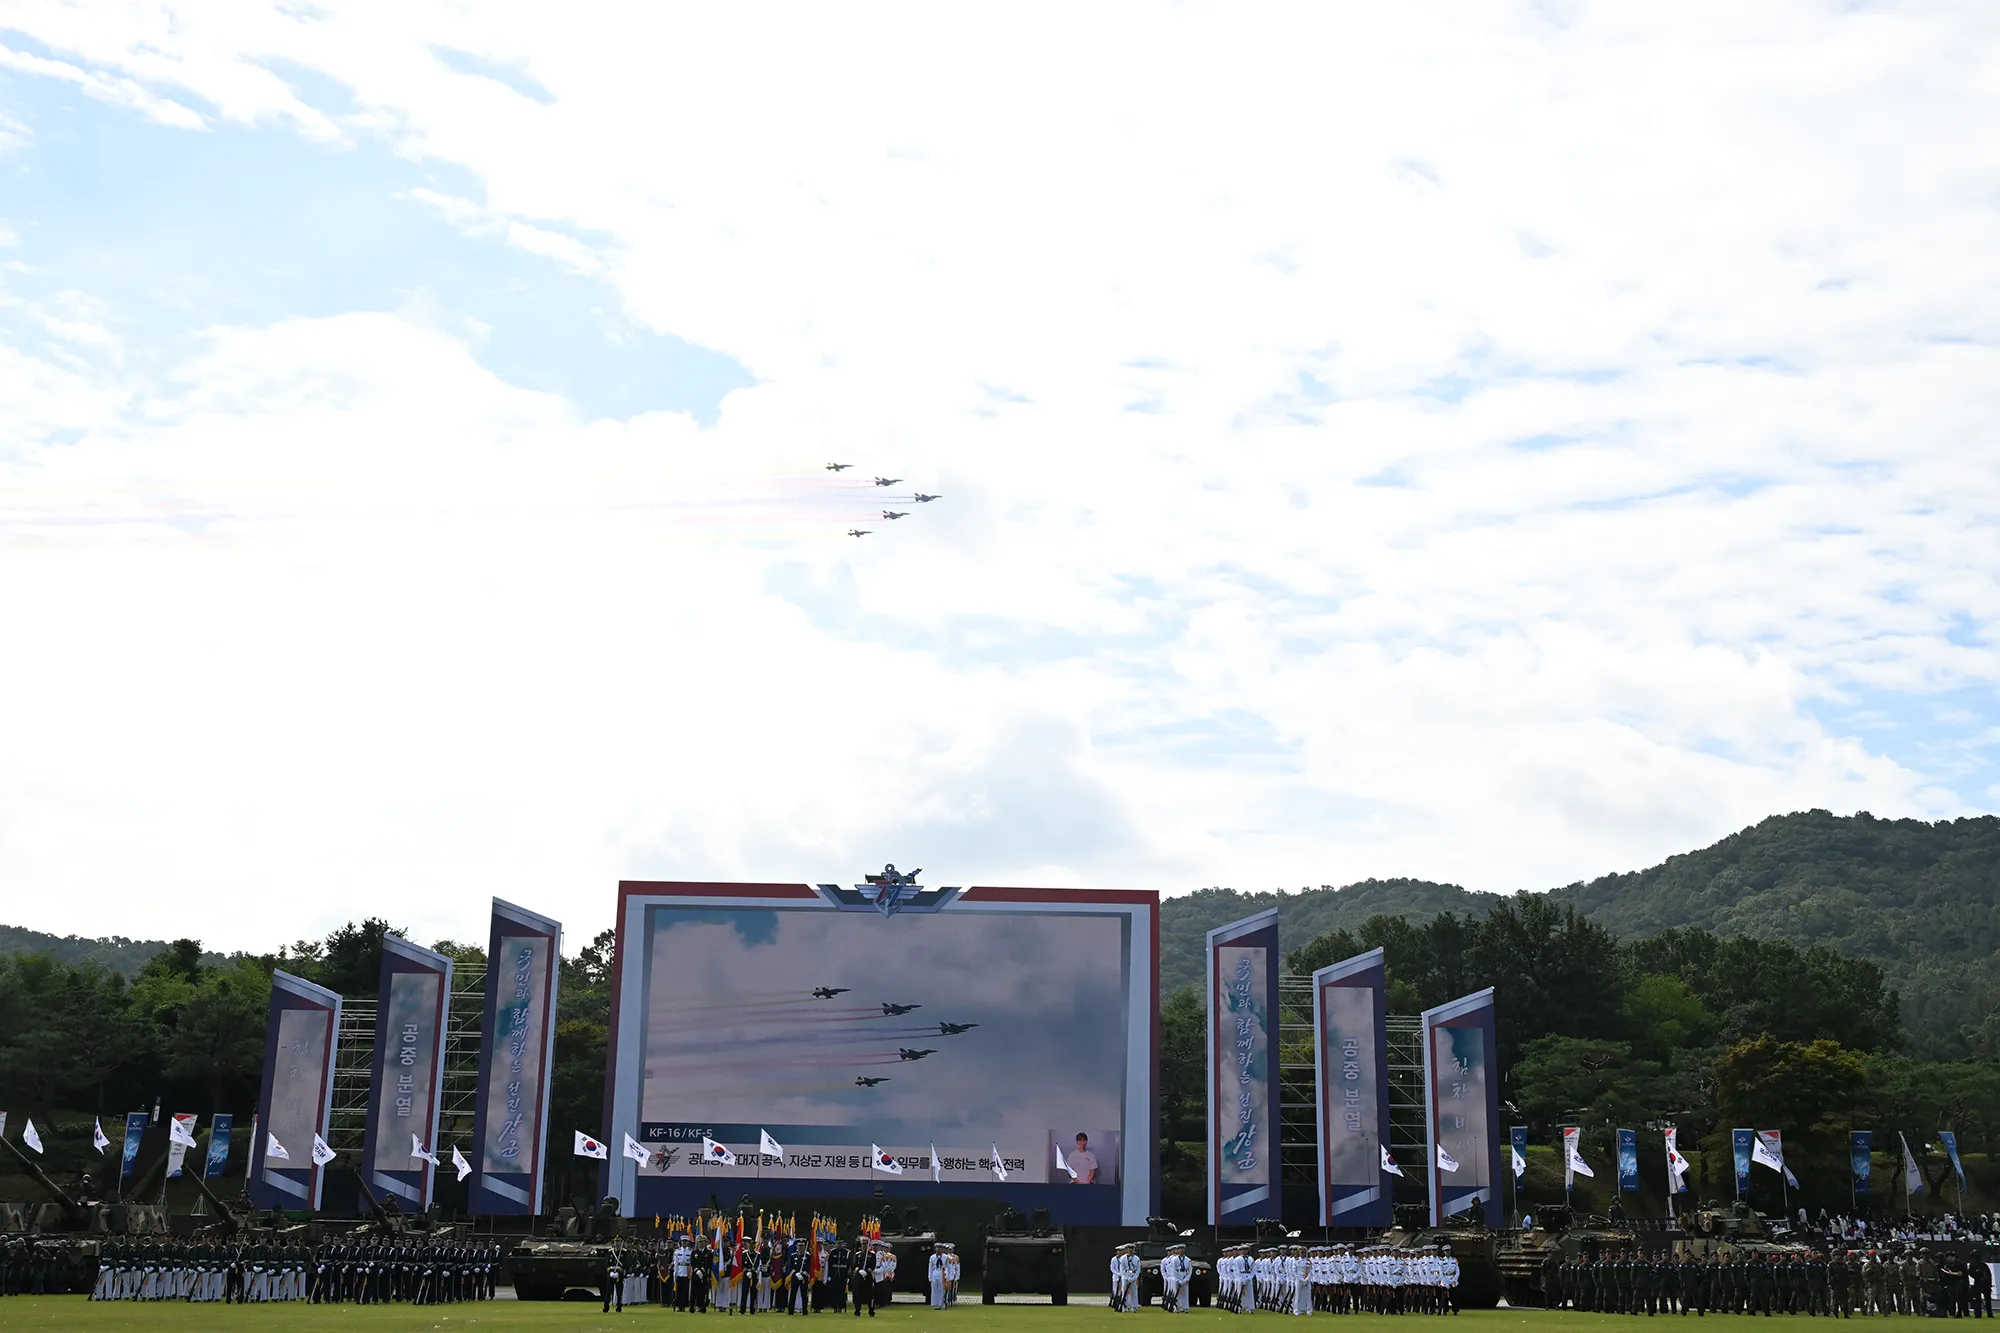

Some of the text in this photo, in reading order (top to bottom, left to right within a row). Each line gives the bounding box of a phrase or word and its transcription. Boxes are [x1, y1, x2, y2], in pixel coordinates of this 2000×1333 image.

[516, 949, 532, 999] 국민과
[1236, 959, 1252, 1009] 국민과
[510, 1007, 529, 1073] 함께하는
[1236, 1018, 1255, 1084] 함께하는
[395, 1024, 419, 1117] 공중 분열
[1342, 1038, 1361, 1132] 공중 분열
[1452, 1057, 1469, 1099] 힘찬
[789, 1155, 822, 1168] 지상군
[824, 1156, 846, 1168] 지원
[849, 1156, 860, 1168] 등
[1003, 1158, 1025, 1172] 전력
